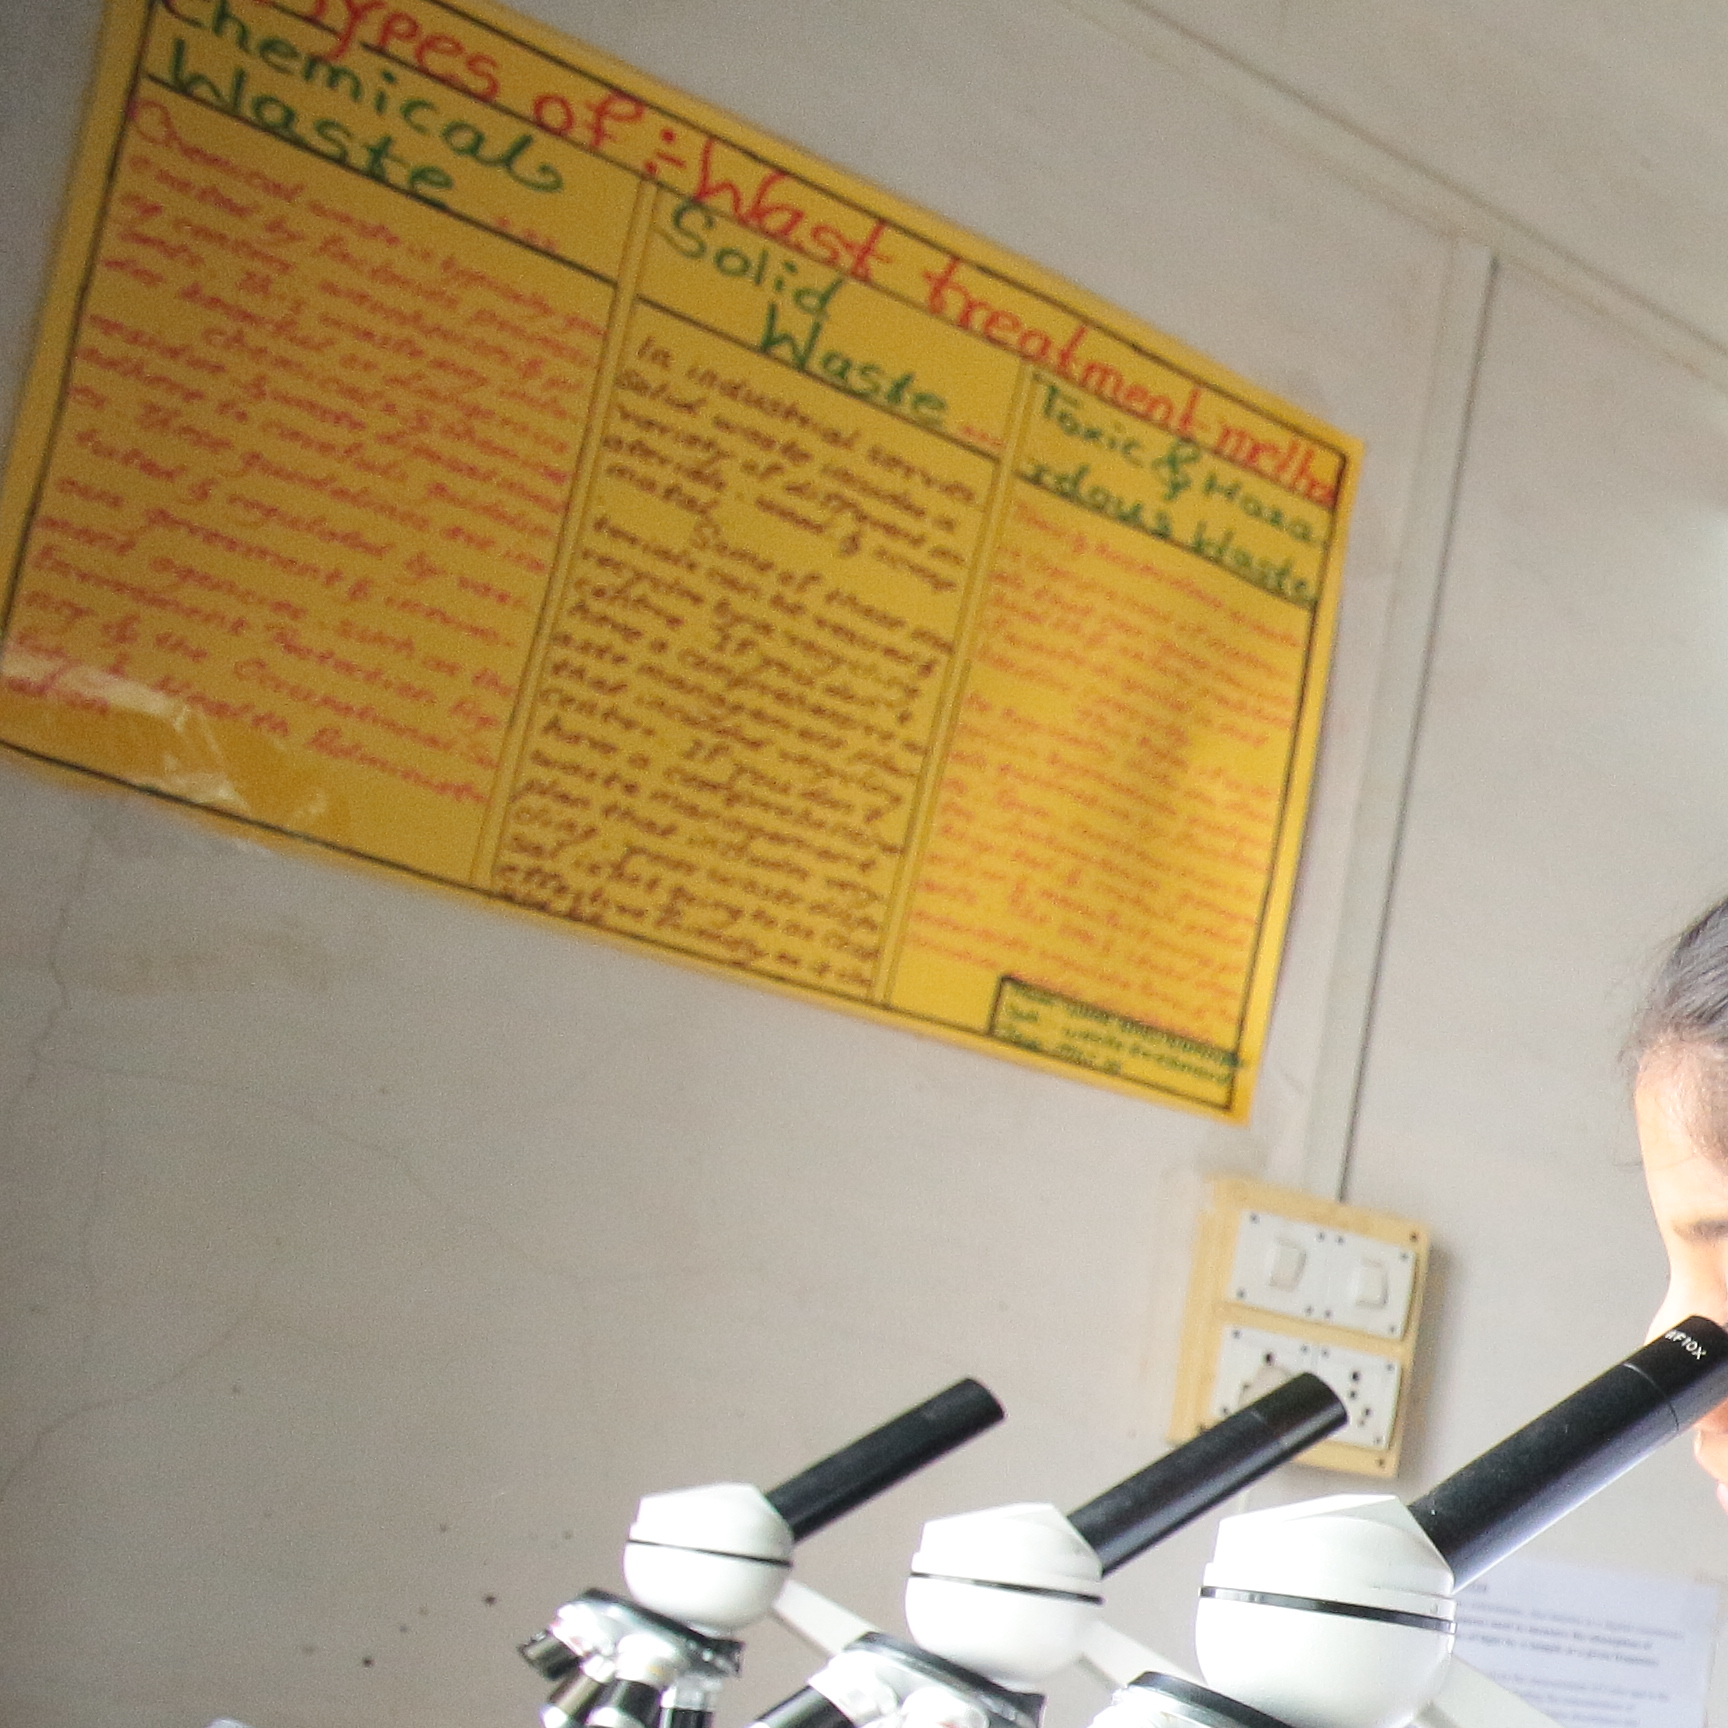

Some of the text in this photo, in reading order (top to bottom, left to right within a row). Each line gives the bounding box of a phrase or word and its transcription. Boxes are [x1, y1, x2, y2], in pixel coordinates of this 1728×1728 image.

[168, 38, 455, 195] Waste
[297, 0, 500, 102] ypes
[532, 93, 645, 152] of
[692, 136, 893, 284] Wast
[672, 198, 846, 312] Solid
[760, 302, 948, 420] Waste
[1040, 384, 1144, 470] Toxic
[1150, 437, 1203, 502] &
